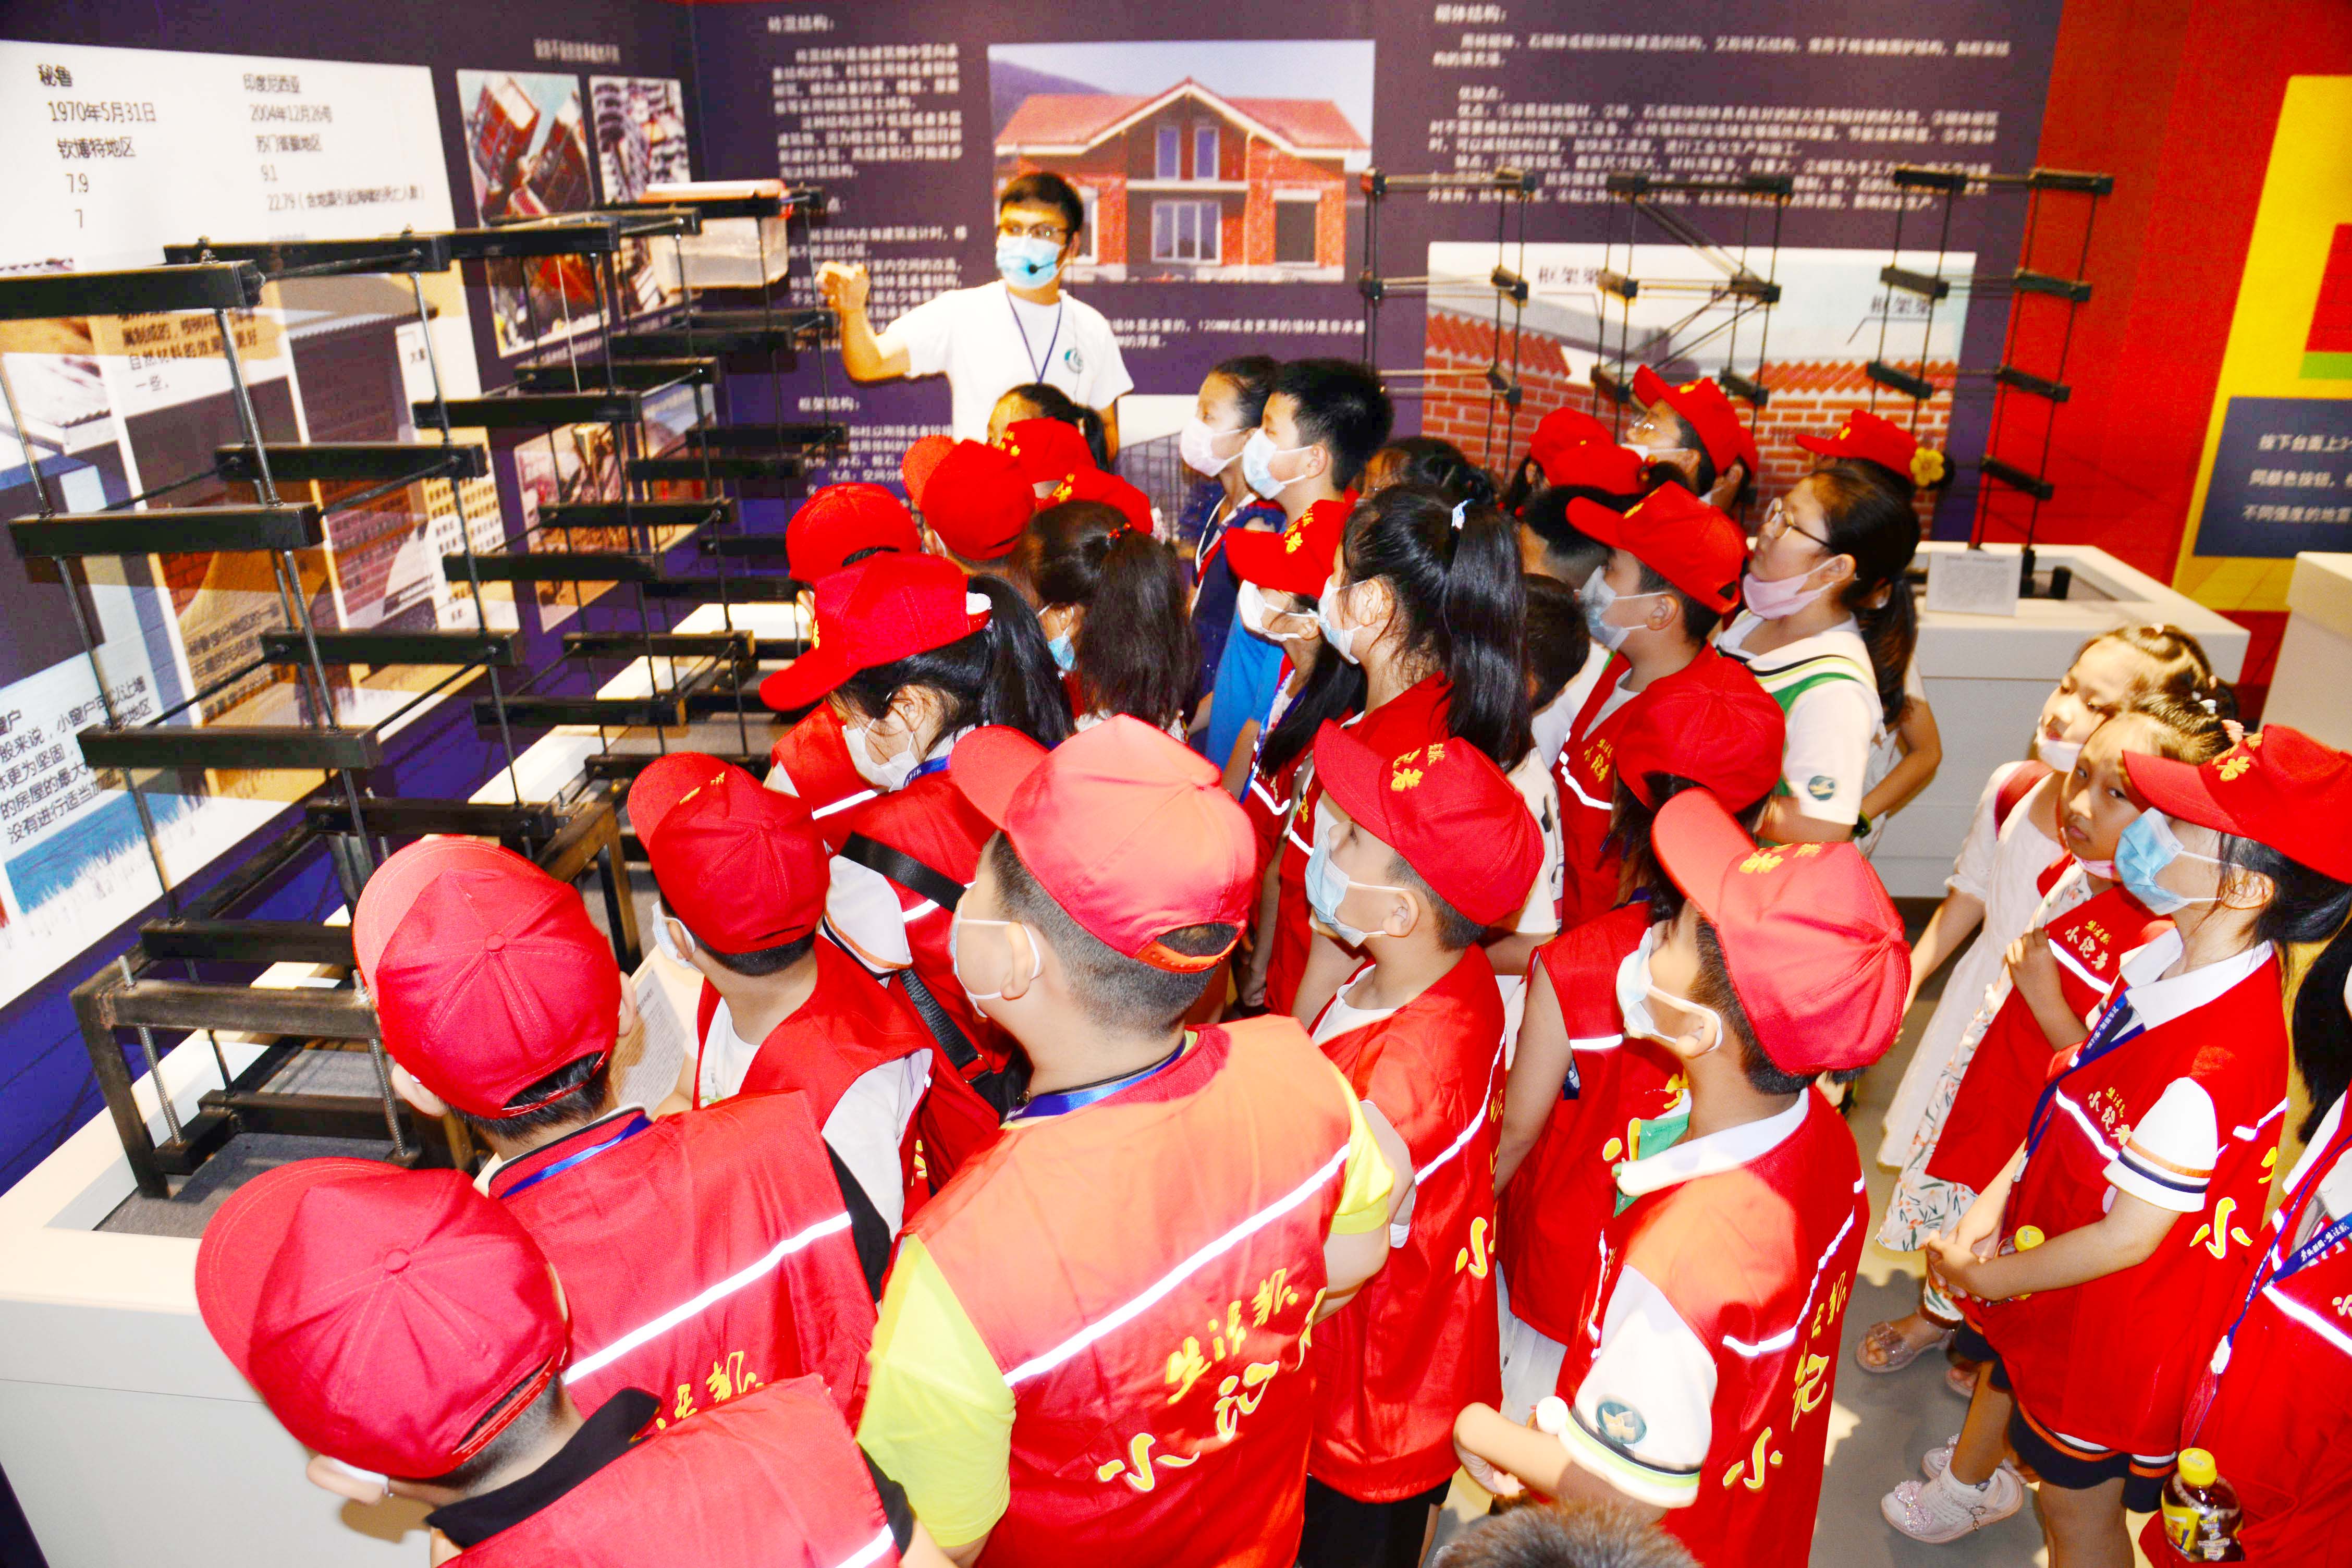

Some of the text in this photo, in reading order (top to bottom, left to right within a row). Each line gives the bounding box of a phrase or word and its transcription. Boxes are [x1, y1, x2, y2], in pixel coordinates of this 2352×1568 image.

[38, 64, 72, 87] 秘鲁
[48, 101, 156, 123] 1970年5月31日
[66, 173, 89, 193] 7.9
[2065, 926, 2109, 970] 小记者
[2088, 1091, 2133, 1145] 小记者
